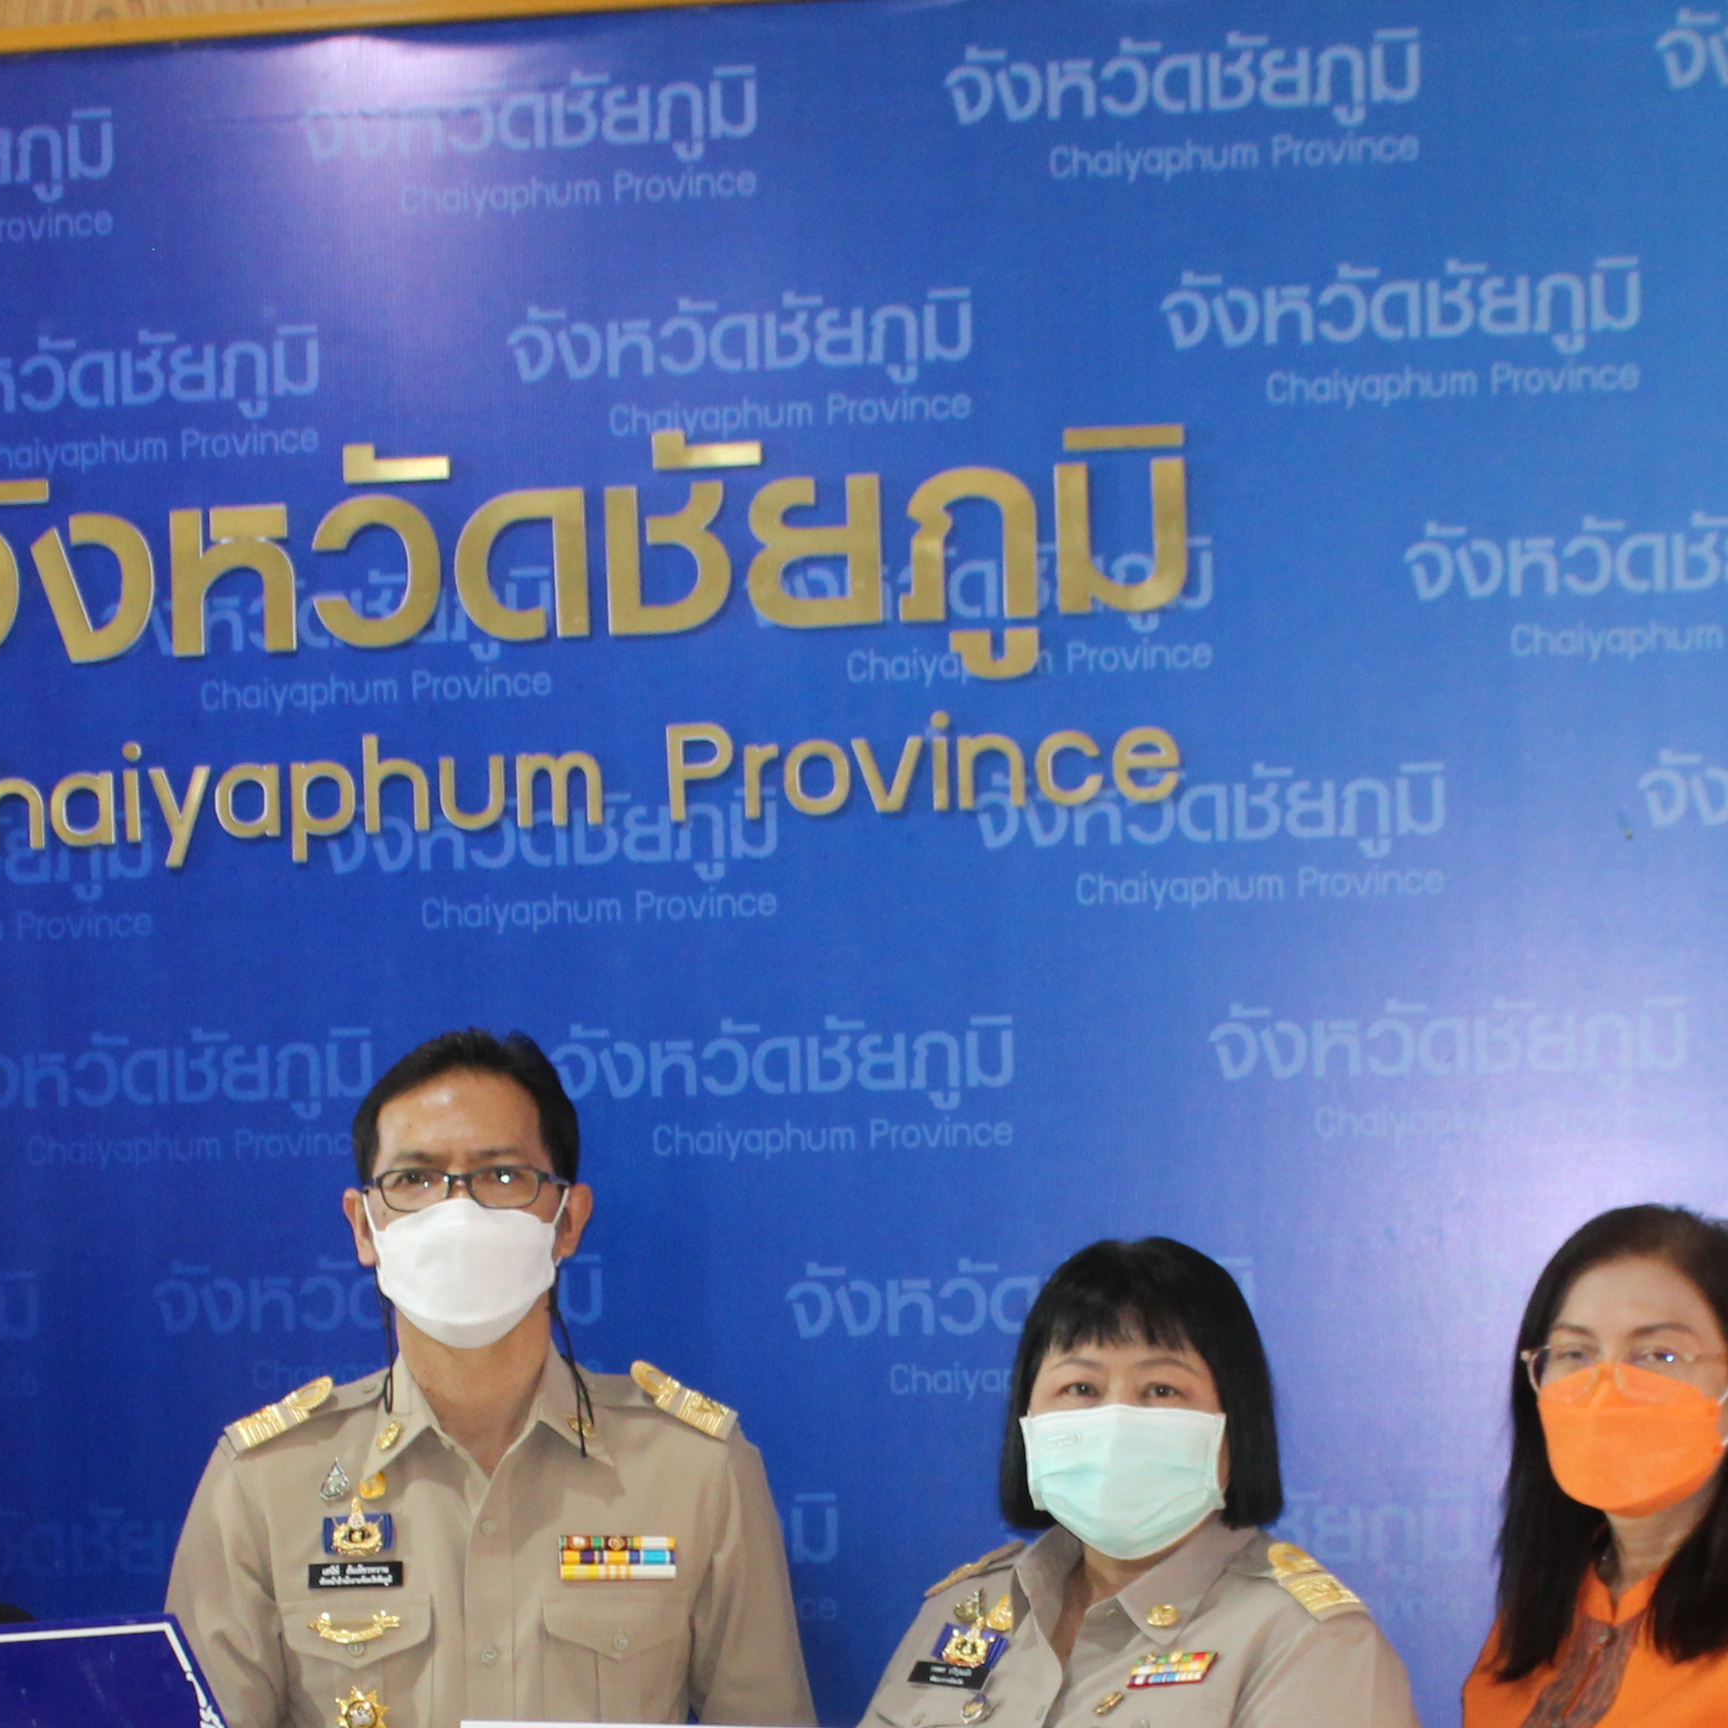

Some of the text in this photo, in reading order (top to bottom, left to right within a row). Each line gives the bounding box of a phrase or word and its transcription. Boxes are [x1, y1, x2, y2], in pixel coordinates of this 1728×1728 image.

[945, 28, 1421, 126] จังหวัดชัยภูมิ
[1047, 129, 1421, 181] Chaiyaphum Province
[1161, 257, 1642, 356] จังหวัดชัยภูมิ
[506, 287, 972, 385] จังหวัดชัยภูมิ
[1266, 356, 1642, 408] Chaiyaphum Province
[179, 424, 319, 461] Province
[666, 710, 1184, 824] Province
[1075, 862, 1447, 911] Chaiyaphum Province
[233, 1126, 357, 1162] Provinc
[651, 1112, 1014, 1160] Chaiyaphum Province
